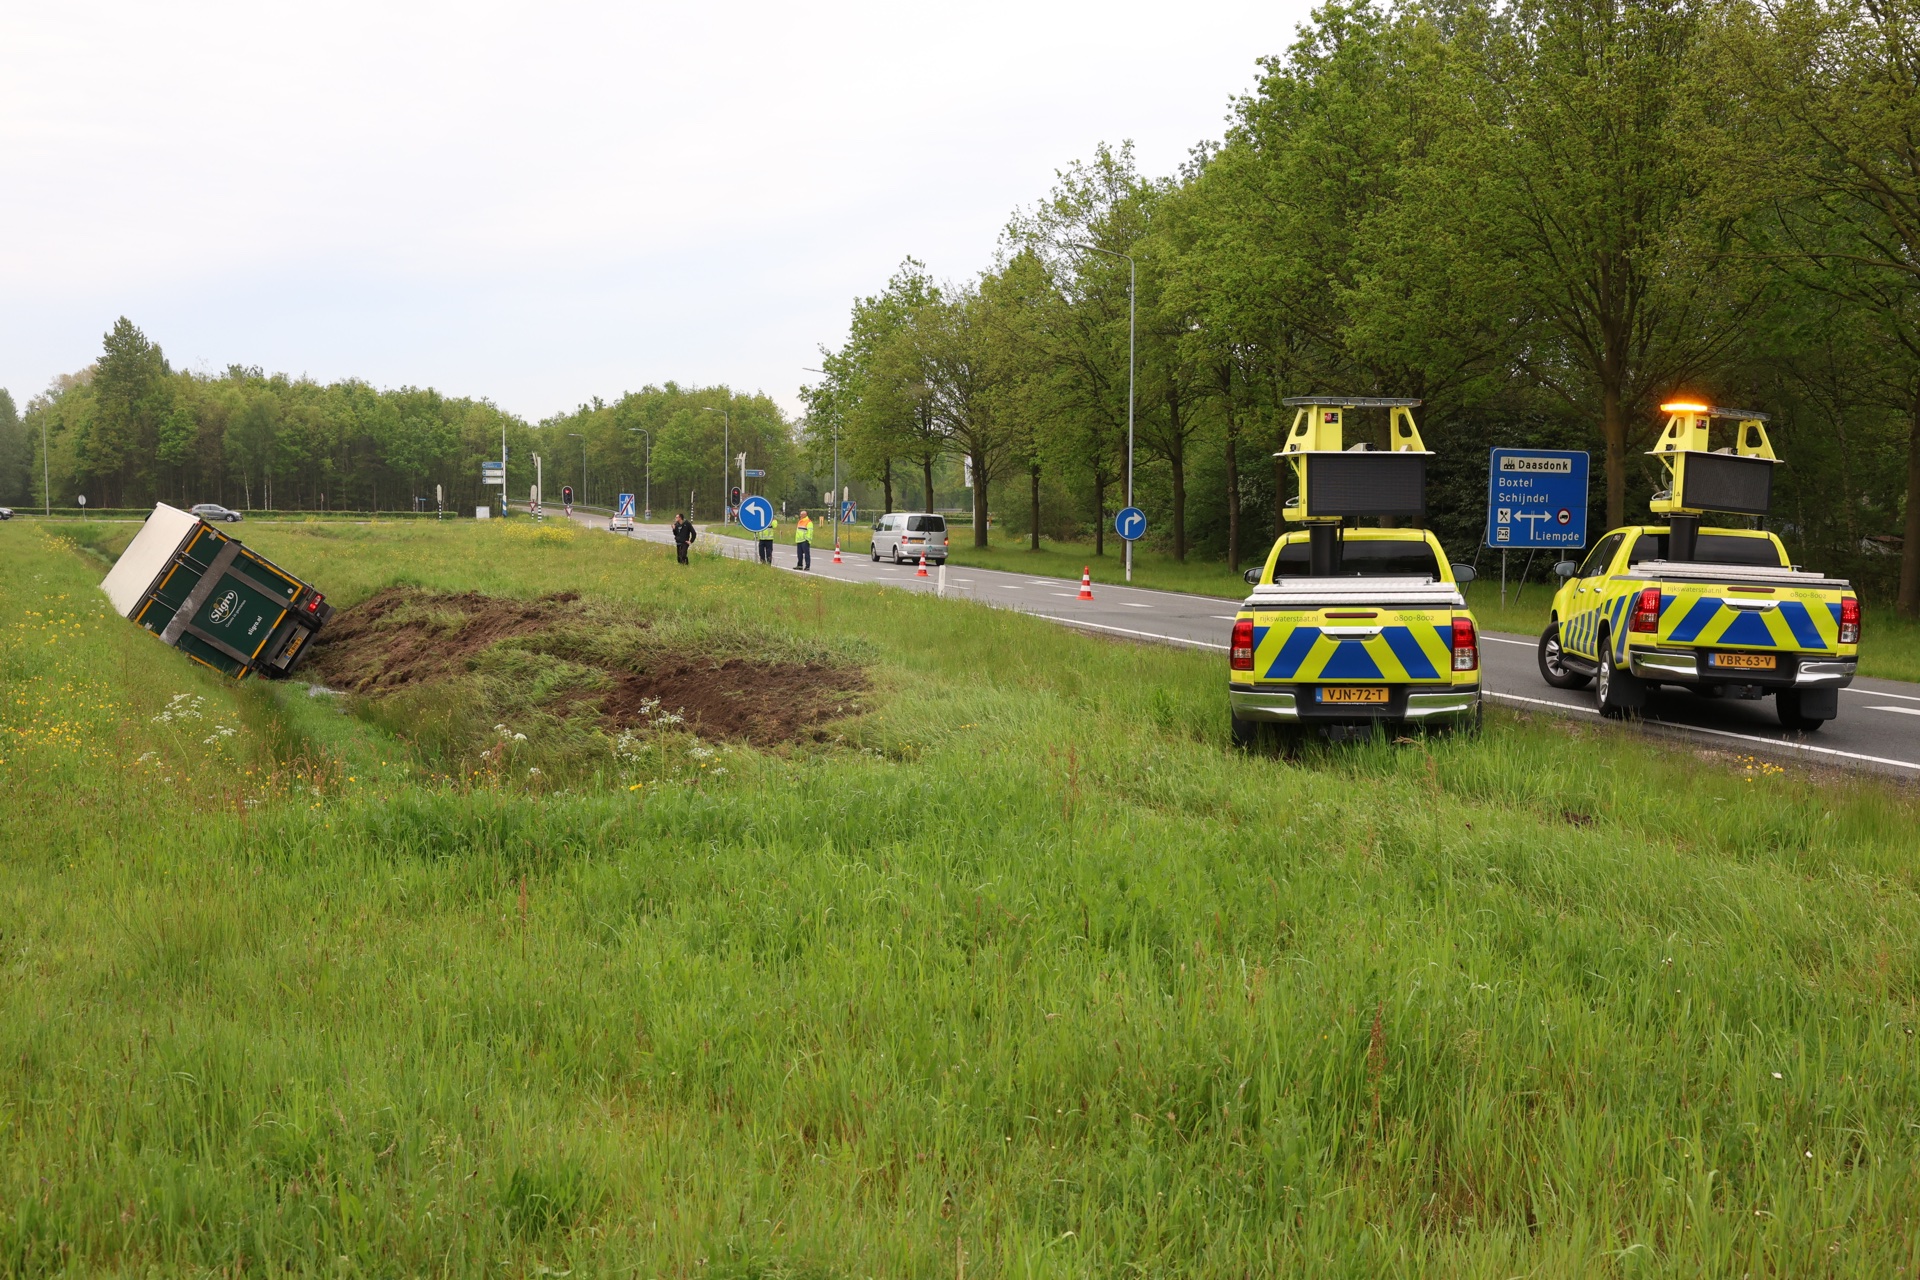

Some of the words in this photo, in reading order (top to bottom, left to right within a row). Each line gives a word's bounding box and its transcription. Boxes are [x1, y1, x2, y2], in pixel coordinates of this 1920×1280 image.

[1518, 459, 1568, 470] Daasdonk
[1499, 478, 1533, 487] Boxtel
[1498, 493, 1549, 505] Schijndel
[1536, 531, 1579, 542] Liempde
[1667, 586, 1722, 594] rijkswaterstaat.nl
[211, 592, 235, 621] Sligro
[1260, 615, 1319, 623] rijkswaterstaat.nl
[248, 615, 263, 636] sligro.nl
[1718, 655, 1772, 666] VBR-63-V
[1327, 689, 1383, 700] VJN-72-T
